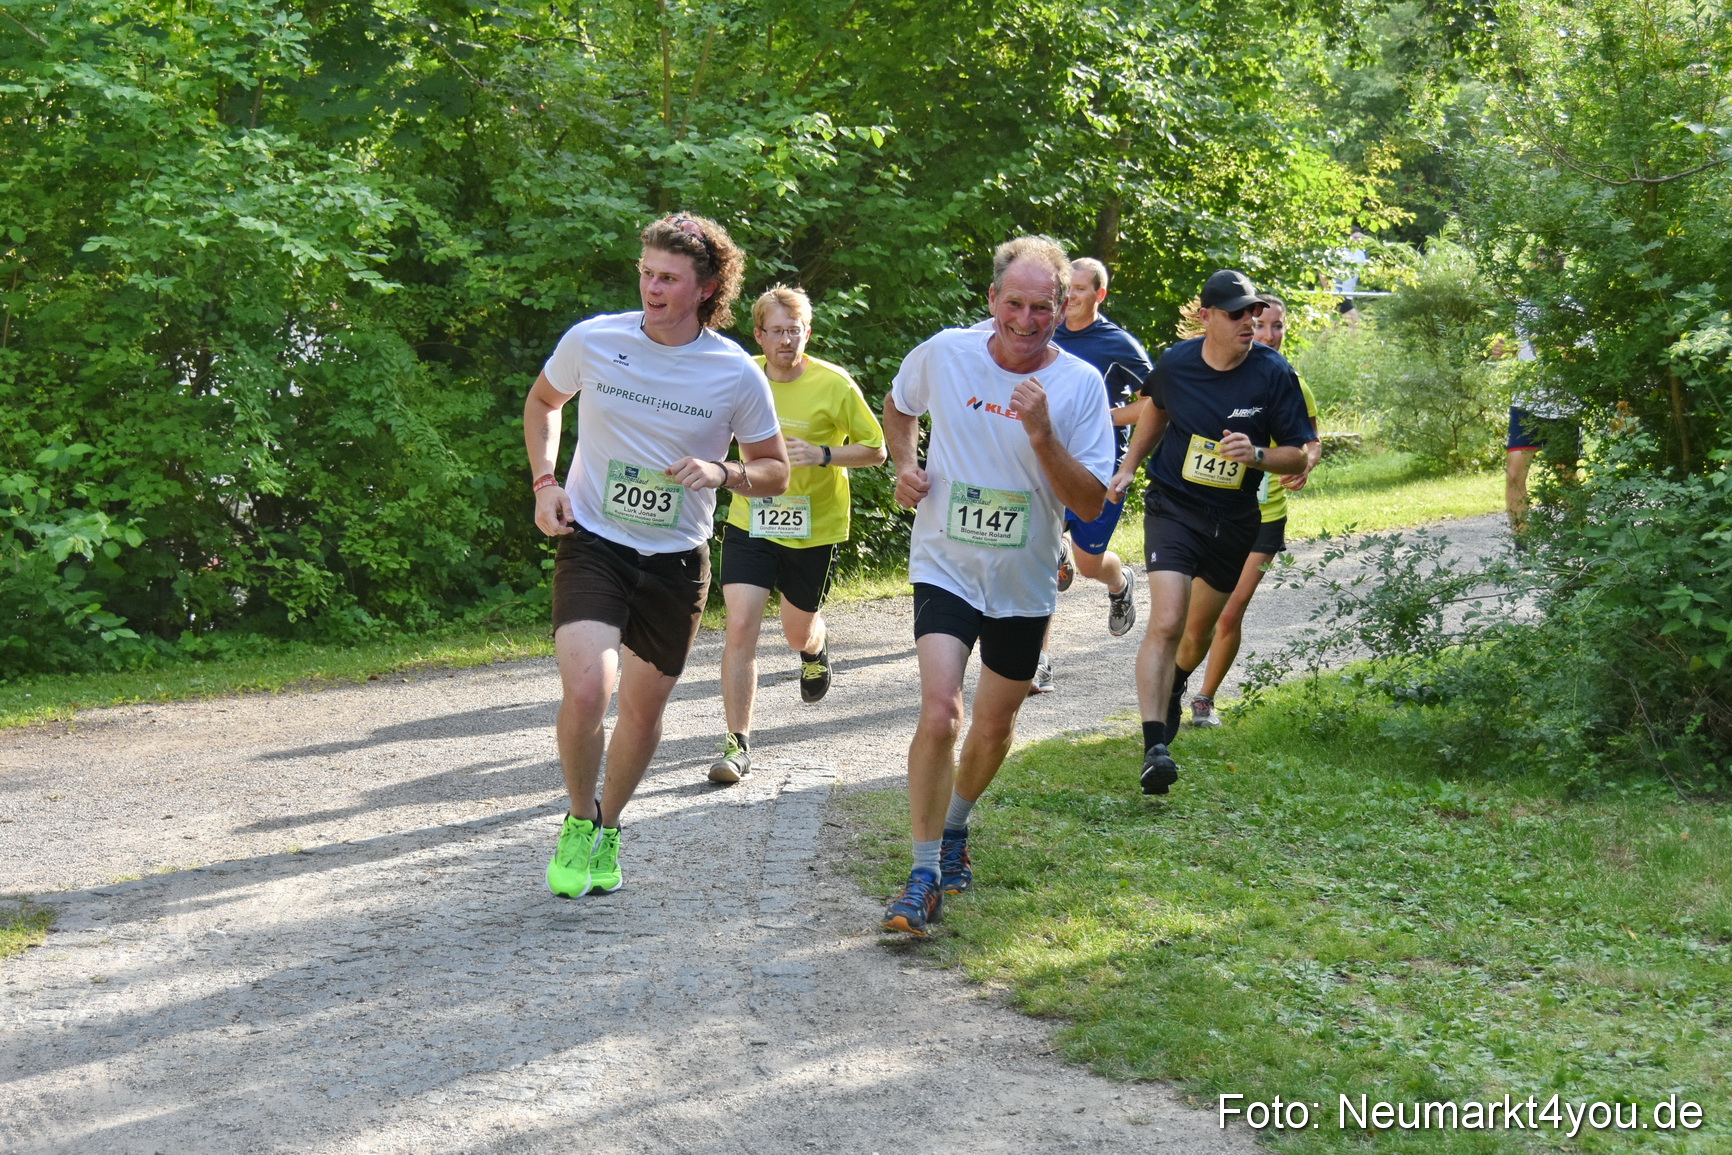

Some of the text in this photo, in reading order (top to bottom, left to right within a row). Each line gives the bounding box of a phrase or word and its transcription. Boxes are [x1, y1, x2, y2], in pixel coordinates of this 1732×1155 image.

[596, 382, 713, 419] RUPPRECHT HOLZBAU
[1194, 454, 1239, 477] 1413
[612, 483, 672, 512] 2093
[638, 509, 657, 518] Jonas
[757, 509, 803, 526] 1225
[958, 505, 1018, 532] 1147
[988, 531, 1012, 539] Roland
